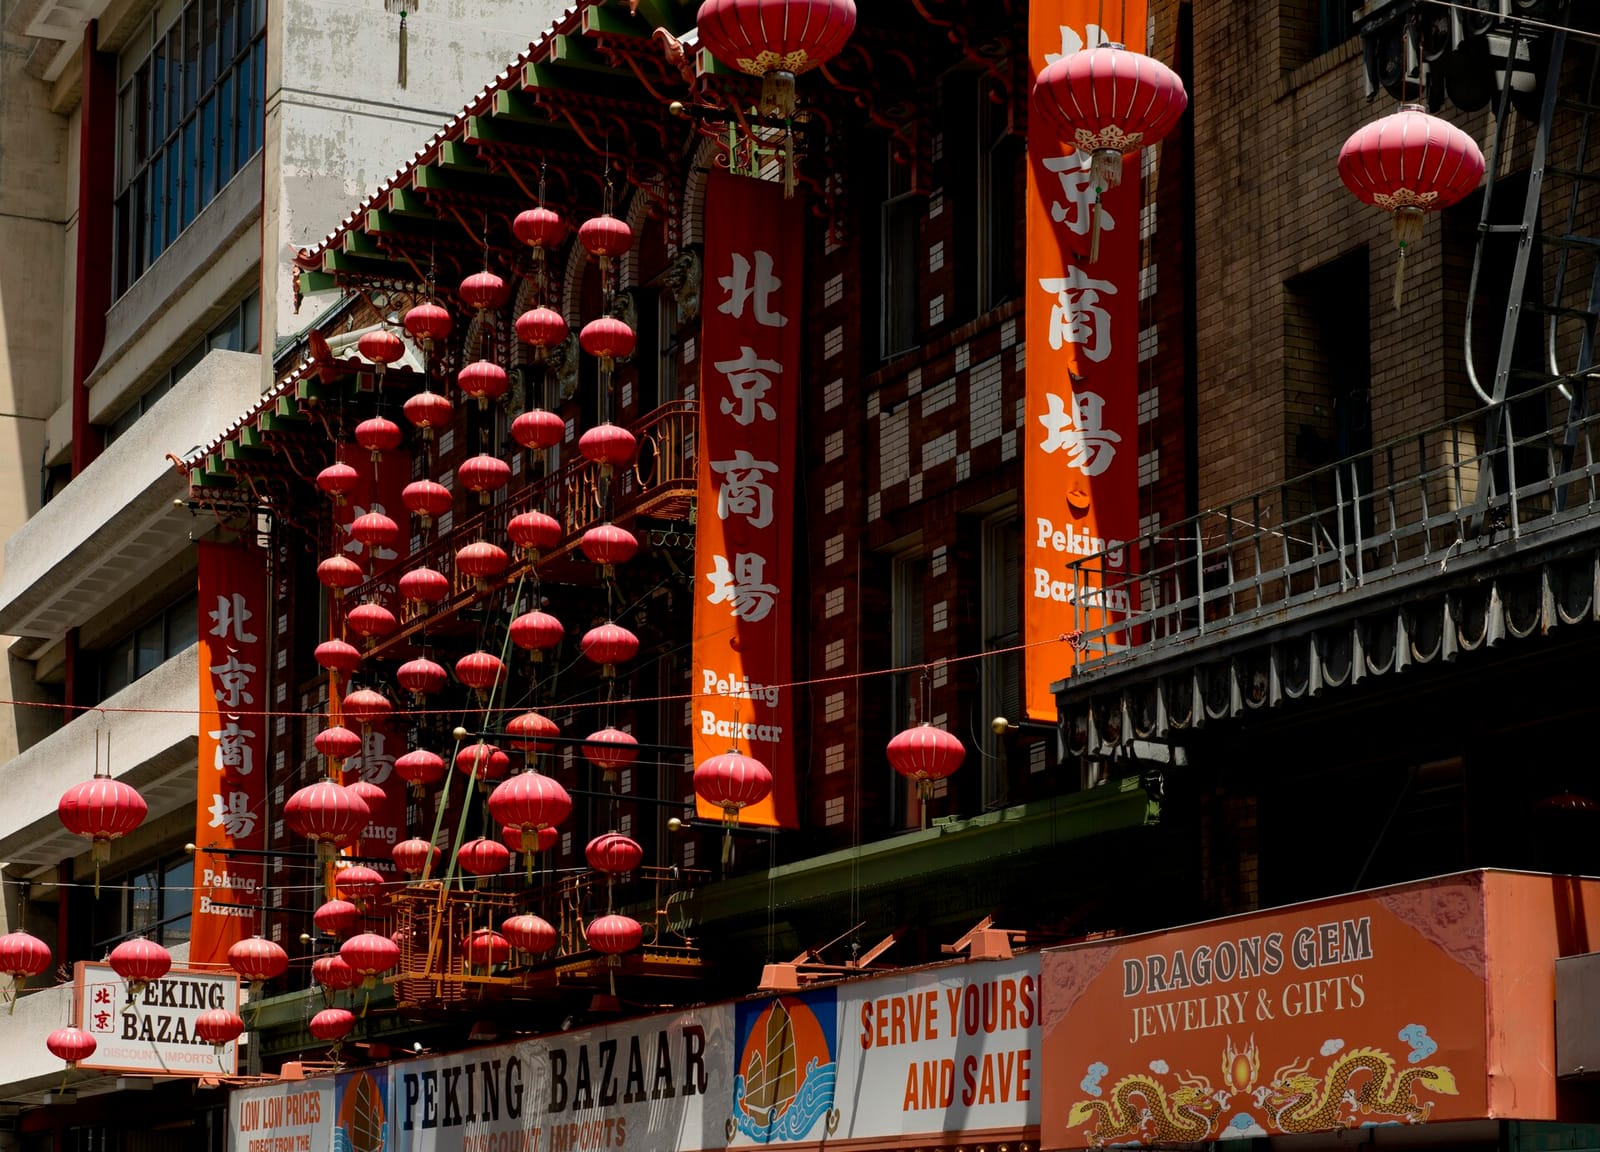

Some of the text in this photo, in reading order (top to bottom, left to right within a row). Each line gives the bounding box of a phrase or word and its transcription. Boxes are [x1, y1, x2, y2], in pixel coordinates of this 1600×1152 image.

[706, 250, 789, 622] 北京商場
[1037, 517, 1124, 567] Peking
[703, 669, 779, 708] Peking
[208, 593, 258, 839] 北京商場
[701, 710, 782, 742] Bazaar
[360, 820, 397, 844] king
[203, 869, 256, 894] Peking
[200, 896, 255, 917] Bazaar
[1123, 916, 1373, 997] DRAGONS GEM
[94, 987, 111, 1030] 北京
[860, 991, 938, 1050] SERVE
[1129, 974, 1366, 1044] JEWELRY & GIFTS
[104, 1047, 214, 1065] DISCOUNT IMPORTS
[403, 1024, 708, 1132] PEKING BAZAAR
[903, 1049, 1031, 1111] AND SAVE
[240, 1091, 320, 1132] LOW LOW PRICES
[249, 1135, 310, 1152] DIRECT FROM THE
[549, 1117, 626, 1152] IMPORTS
